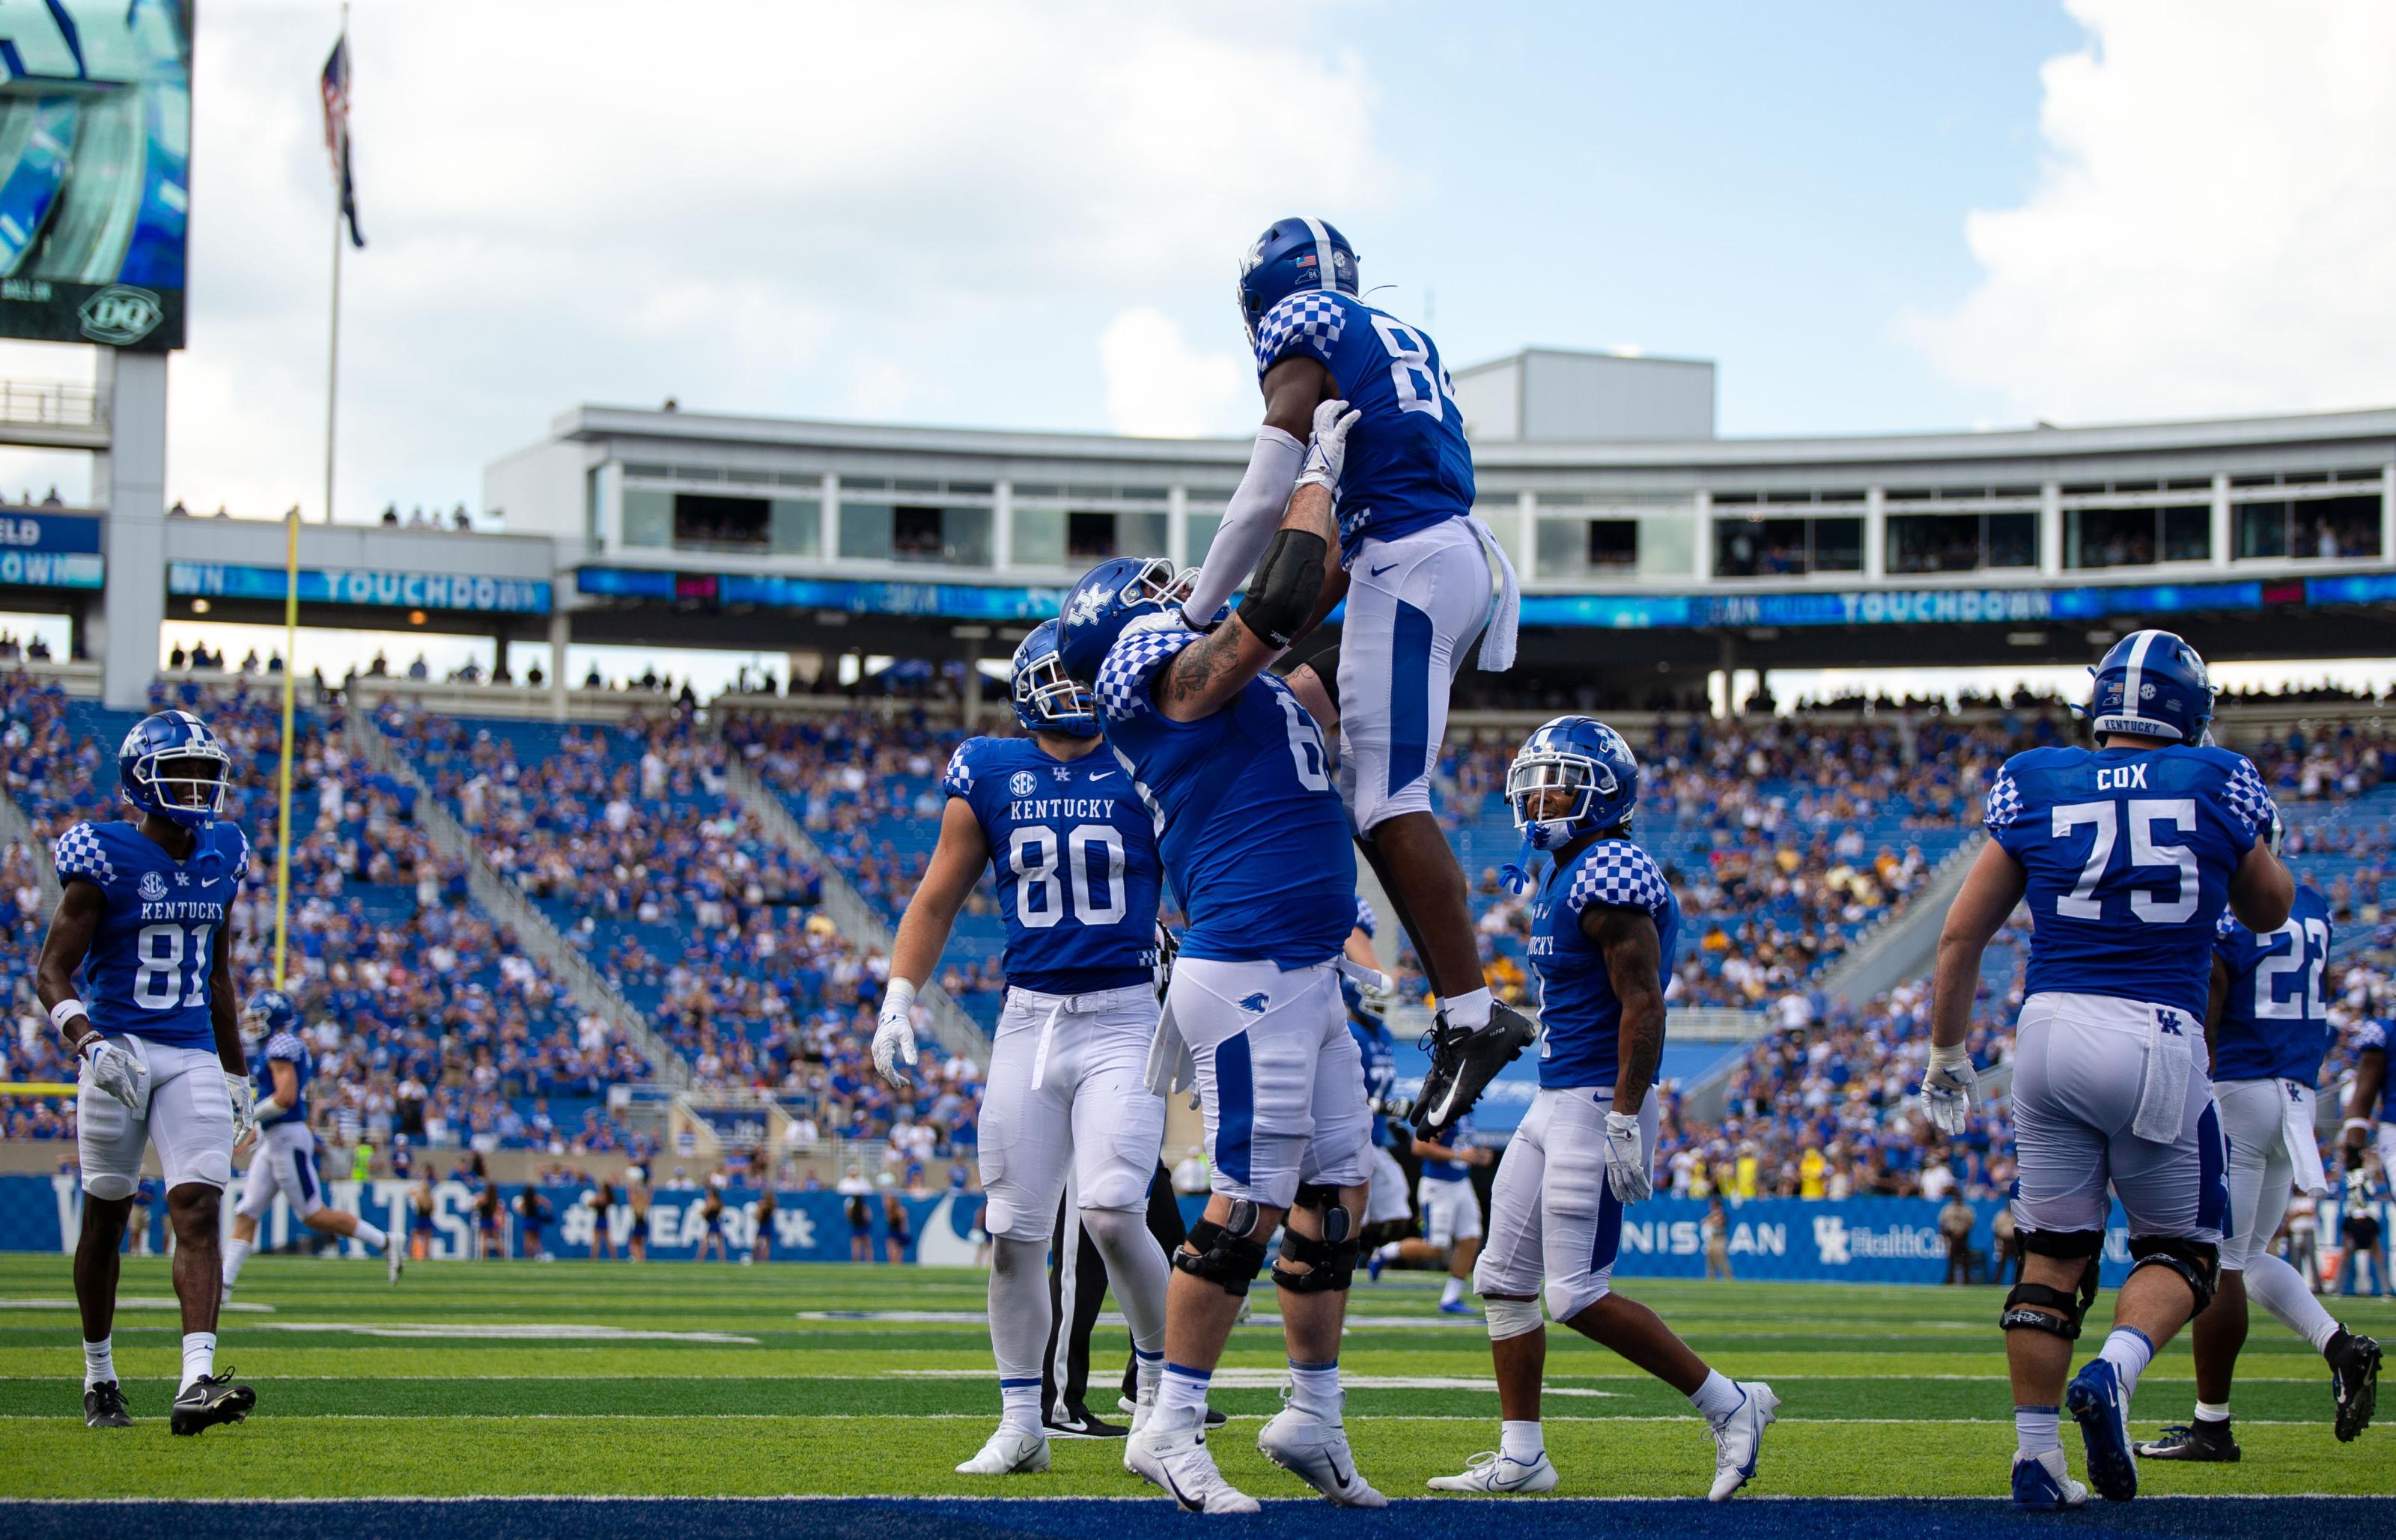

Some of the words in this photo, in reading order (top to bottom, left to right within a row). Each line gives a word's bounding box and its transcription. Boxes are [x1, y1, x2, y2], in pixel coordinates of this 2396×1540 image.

[95, 297, 150, 333] DQ
[2104, 719, 2161, 734] KENTUCKY
[1012, 772, 1036, 796] SEC
[2097, 763, 2148, 791] COX
[1010, 799, 1115, 820] KENTUCKY
[2052, 799, 2201, 923] 75
[143, 873, 162, 894] SEC
[1009, 824, 1126, 928] 80
[141, 901, 223, 920] KENTUCKY
[133, 924, 213, 1009] 81
[2156, 1008, 2183, 1037] UK
